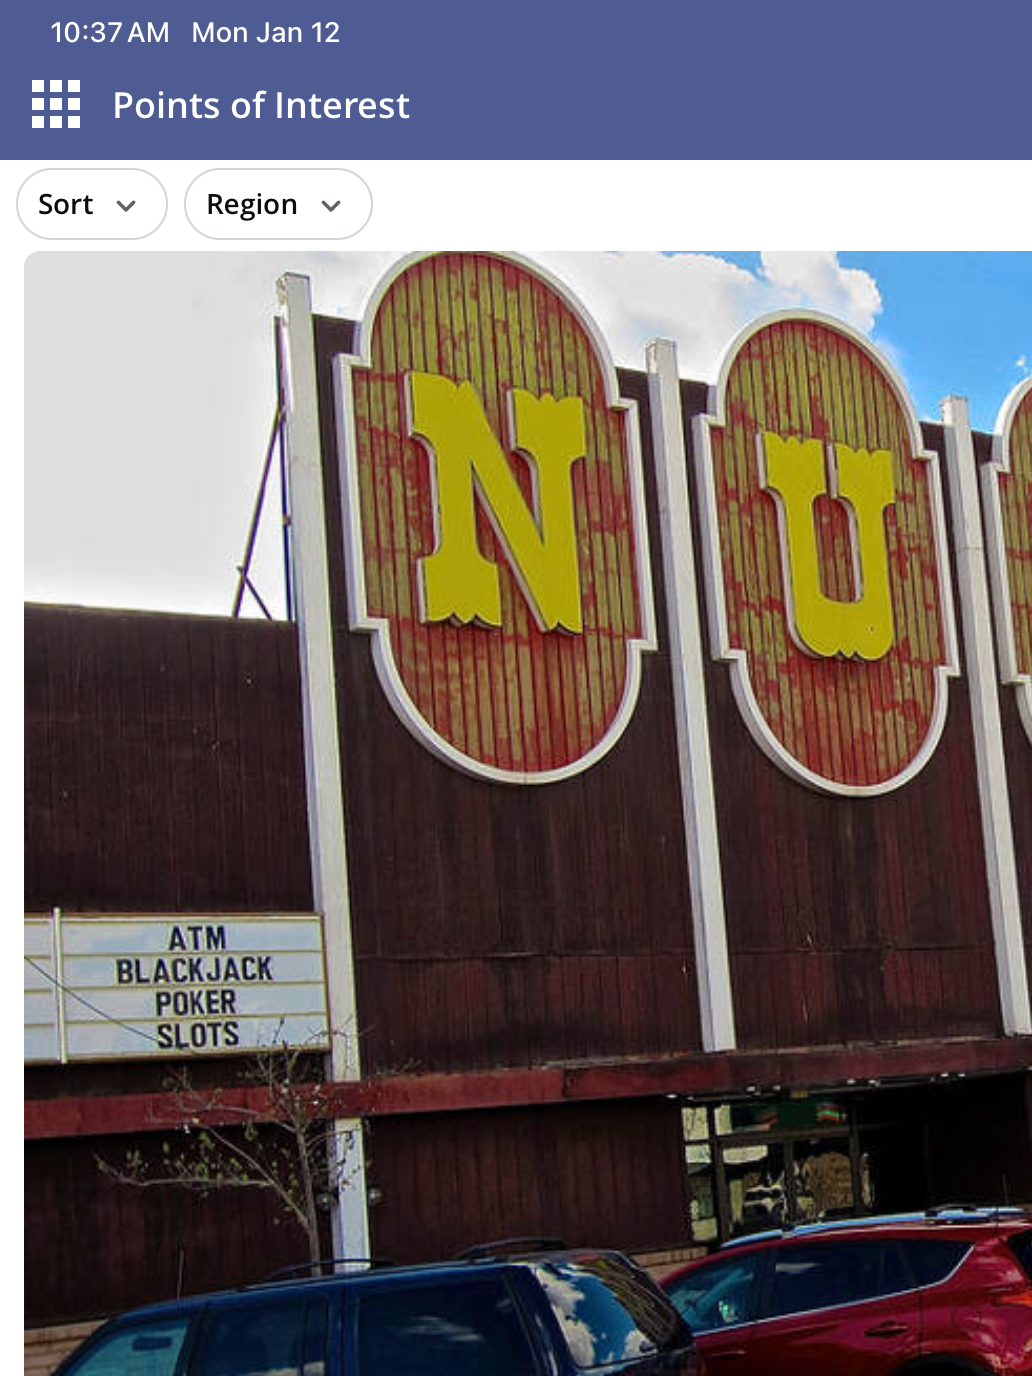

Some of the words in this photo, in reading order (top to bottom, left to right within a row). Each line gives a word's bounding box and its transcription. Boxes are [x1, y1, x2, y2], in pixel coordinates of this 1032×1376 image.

[51, 21, 123, 44] 10:37
[192, 21, 248, 43] Mon
[256, 21, 303, 44] Jan
[311, 21, 340, 43] 12
[114, 90, 220, 120] Points
[231, 89, 268, 120] of
[276, 91, 410, 120] Interest
[38, 192, 94, 216] Sort
[207, 192, 297, 222] Region
[168, 925, 227, 951] ATM
[115, 956, 274, 984] BLACKJACK
[155, 989, 237, 1016] POKER
[157, 1021, 240, 1049] SLOTS
